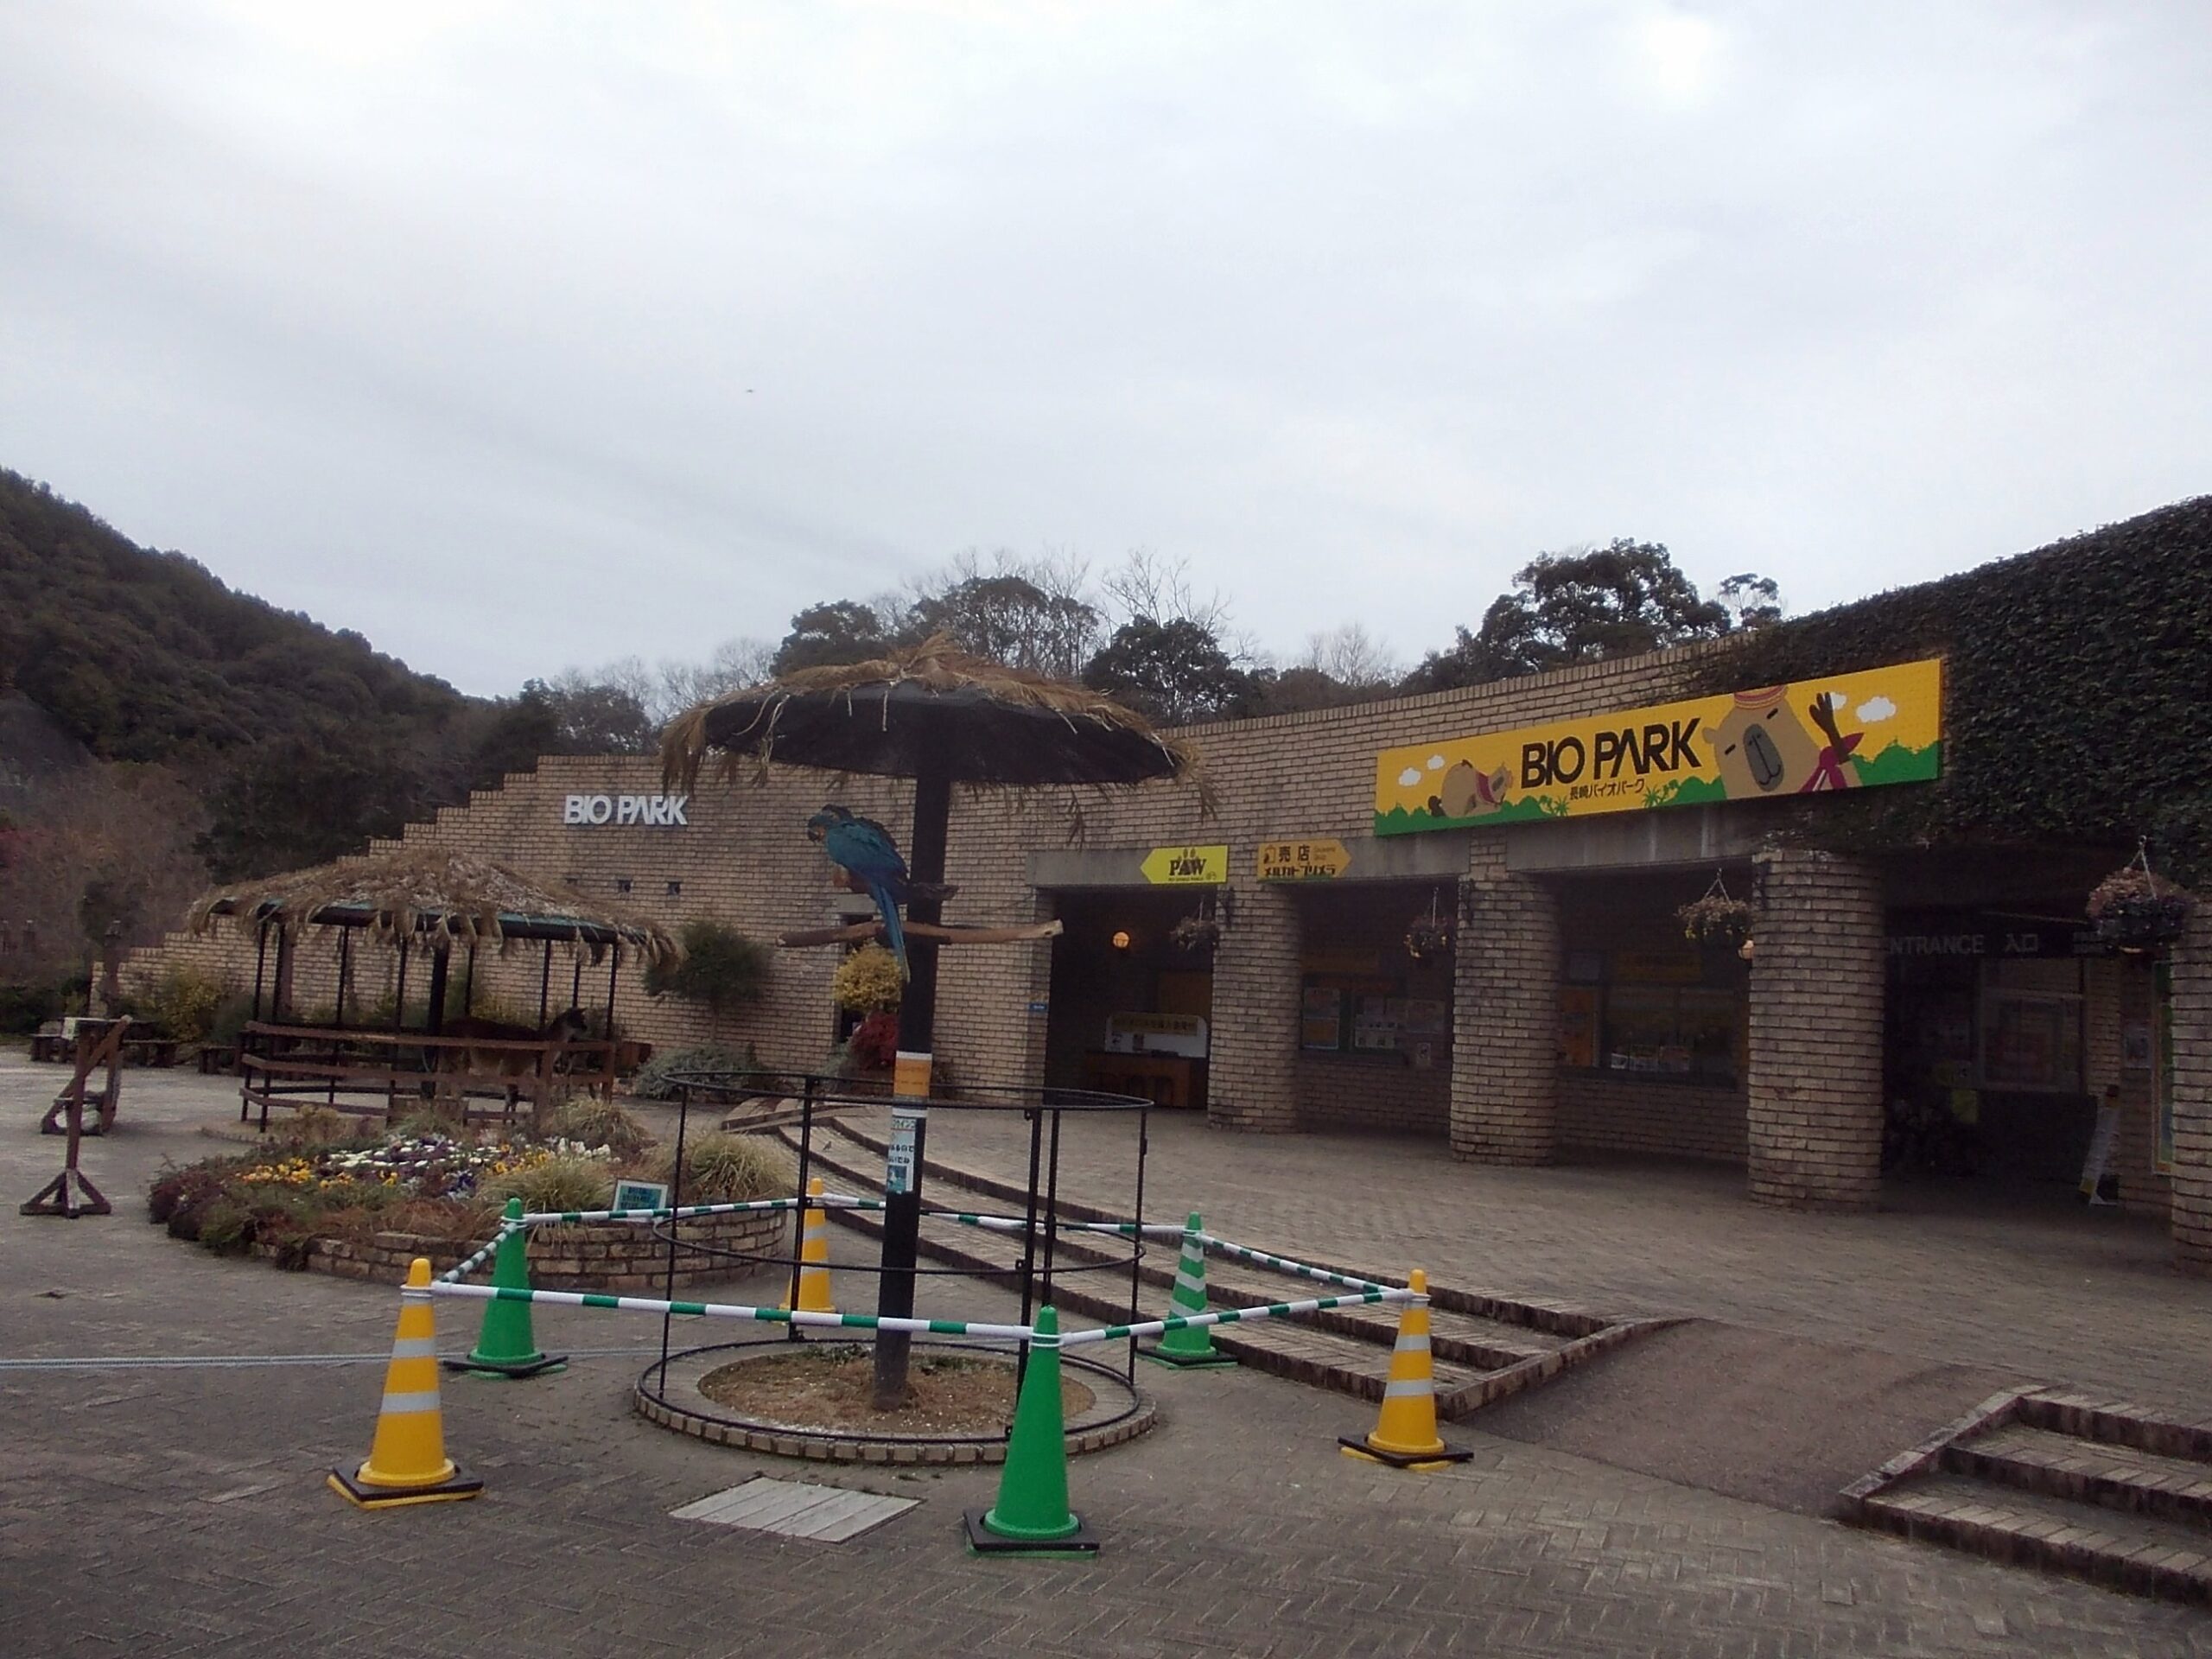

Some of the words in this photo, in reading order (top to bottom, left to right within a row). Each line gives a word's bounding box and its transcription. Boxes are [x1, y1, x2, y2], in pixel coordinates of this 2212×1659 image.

[1521, 736, 1586, 789] BIO
[1593, 717, 1702, 780] PARK
[1569, 779, 1645, 801] 長崎バイオパーク
[564, 795, 613, 824] BIO
[617, 795, 688, 825] PARK
[1169, 858, 1207, 876] PAW
[1889, 933, 1986, 955] NTRANCE
[2005, 933, 2039, 954] 入口
